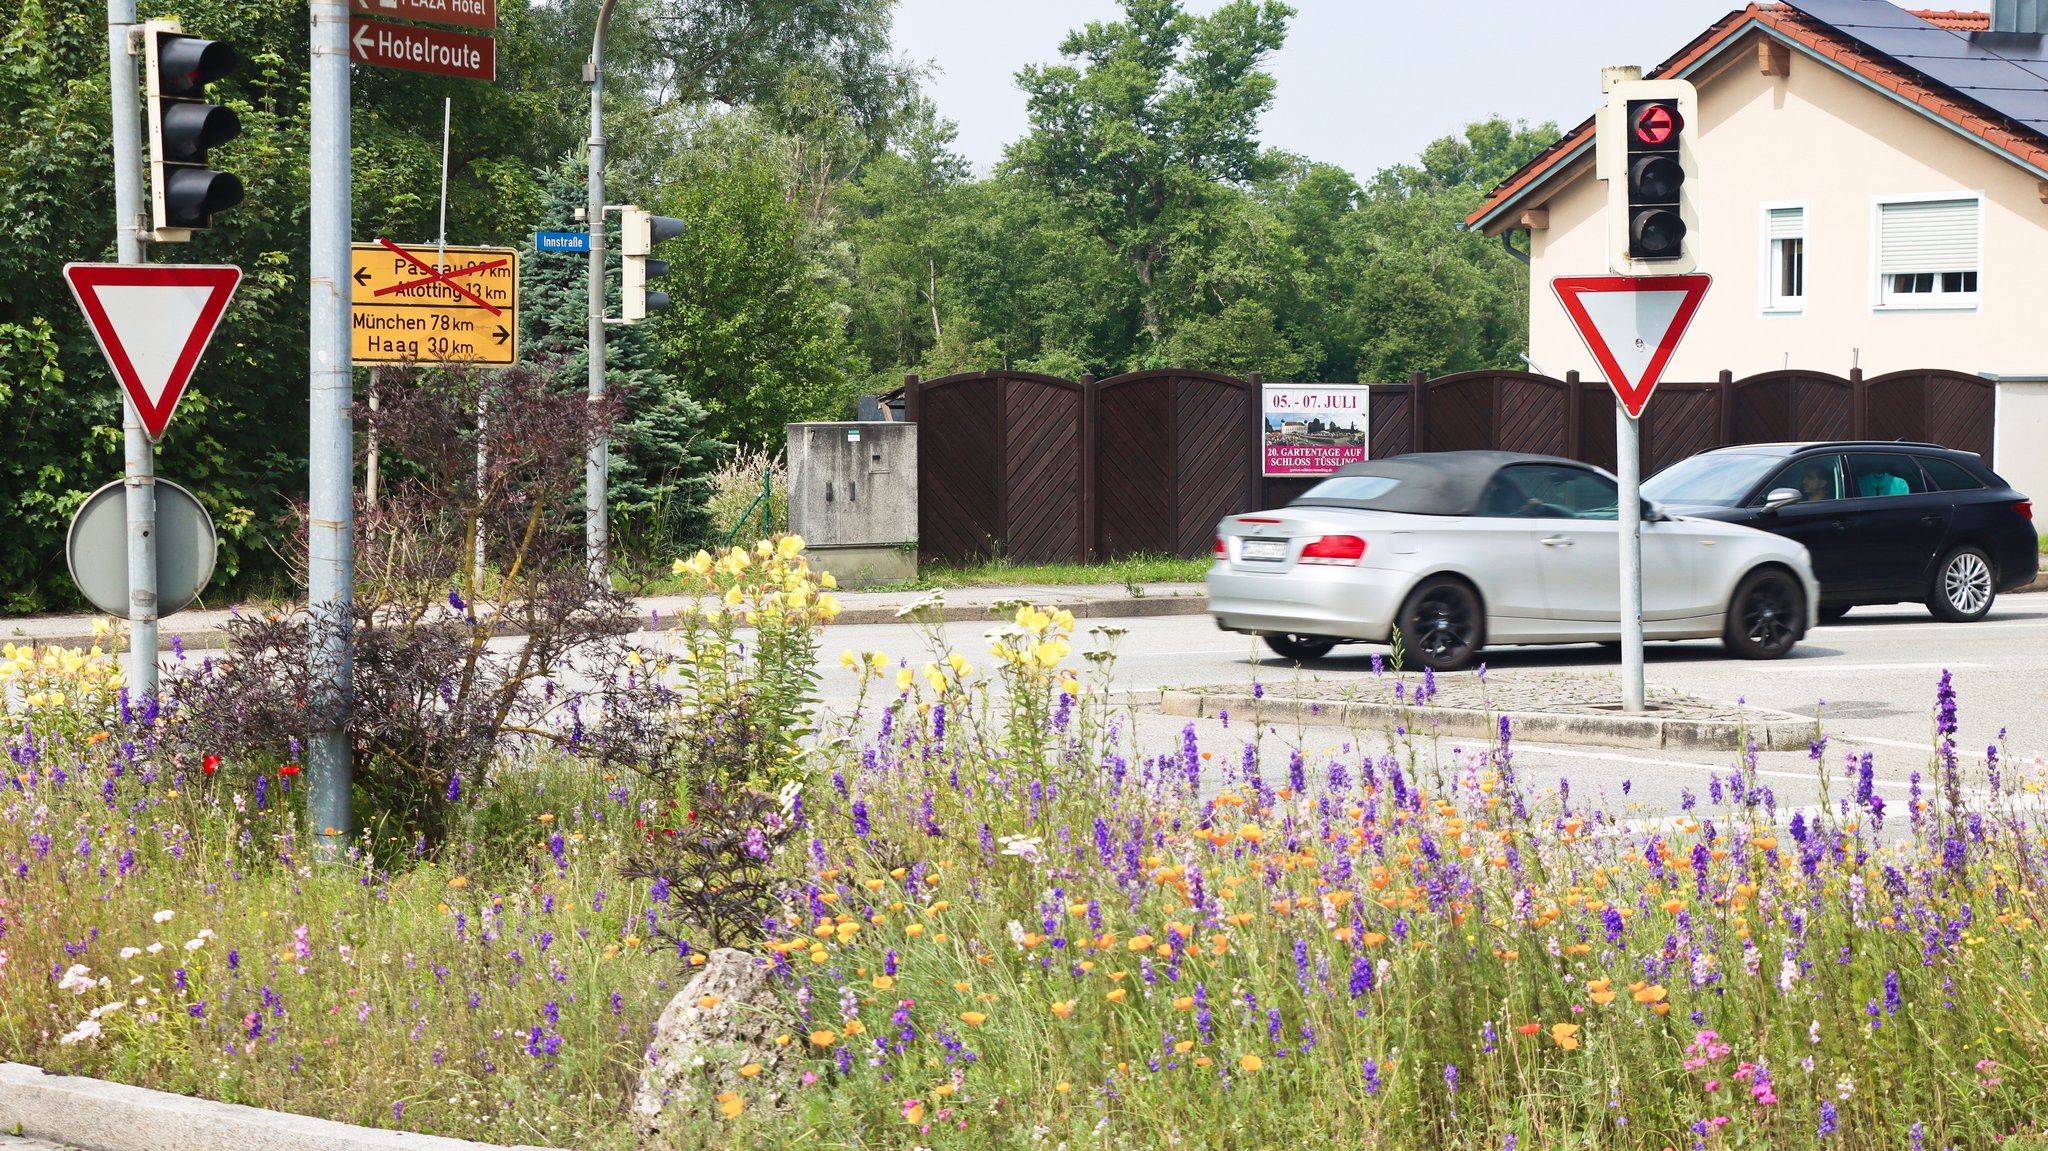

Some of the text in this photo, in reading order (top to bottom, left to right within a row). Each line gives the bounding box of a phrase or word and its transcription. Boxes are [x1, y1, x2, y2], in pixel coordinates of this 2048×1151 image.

[452, 0, 486, 15] Hotel
[378, 30, 481, 70] Hotelroute
[543, 235, 583, 248] Innstraße
[490, 265, 511, 278] km
[466, 283, 481, 298] 13
[485, 285, 507, 299] km
[353, 313, 474, 332] München 78 km
[368, 336, 474, 356] Haag 30 km
[1273, 395, 1291, 408] 05.
[1303, 395, 1321, 408] 07.
[1324, 395, 1357, 409] JULI
[1267, 448, 1362, 457] 20. GARTENTAGE AUF
[1271, 458, 1311, 466] SCHLOSS
